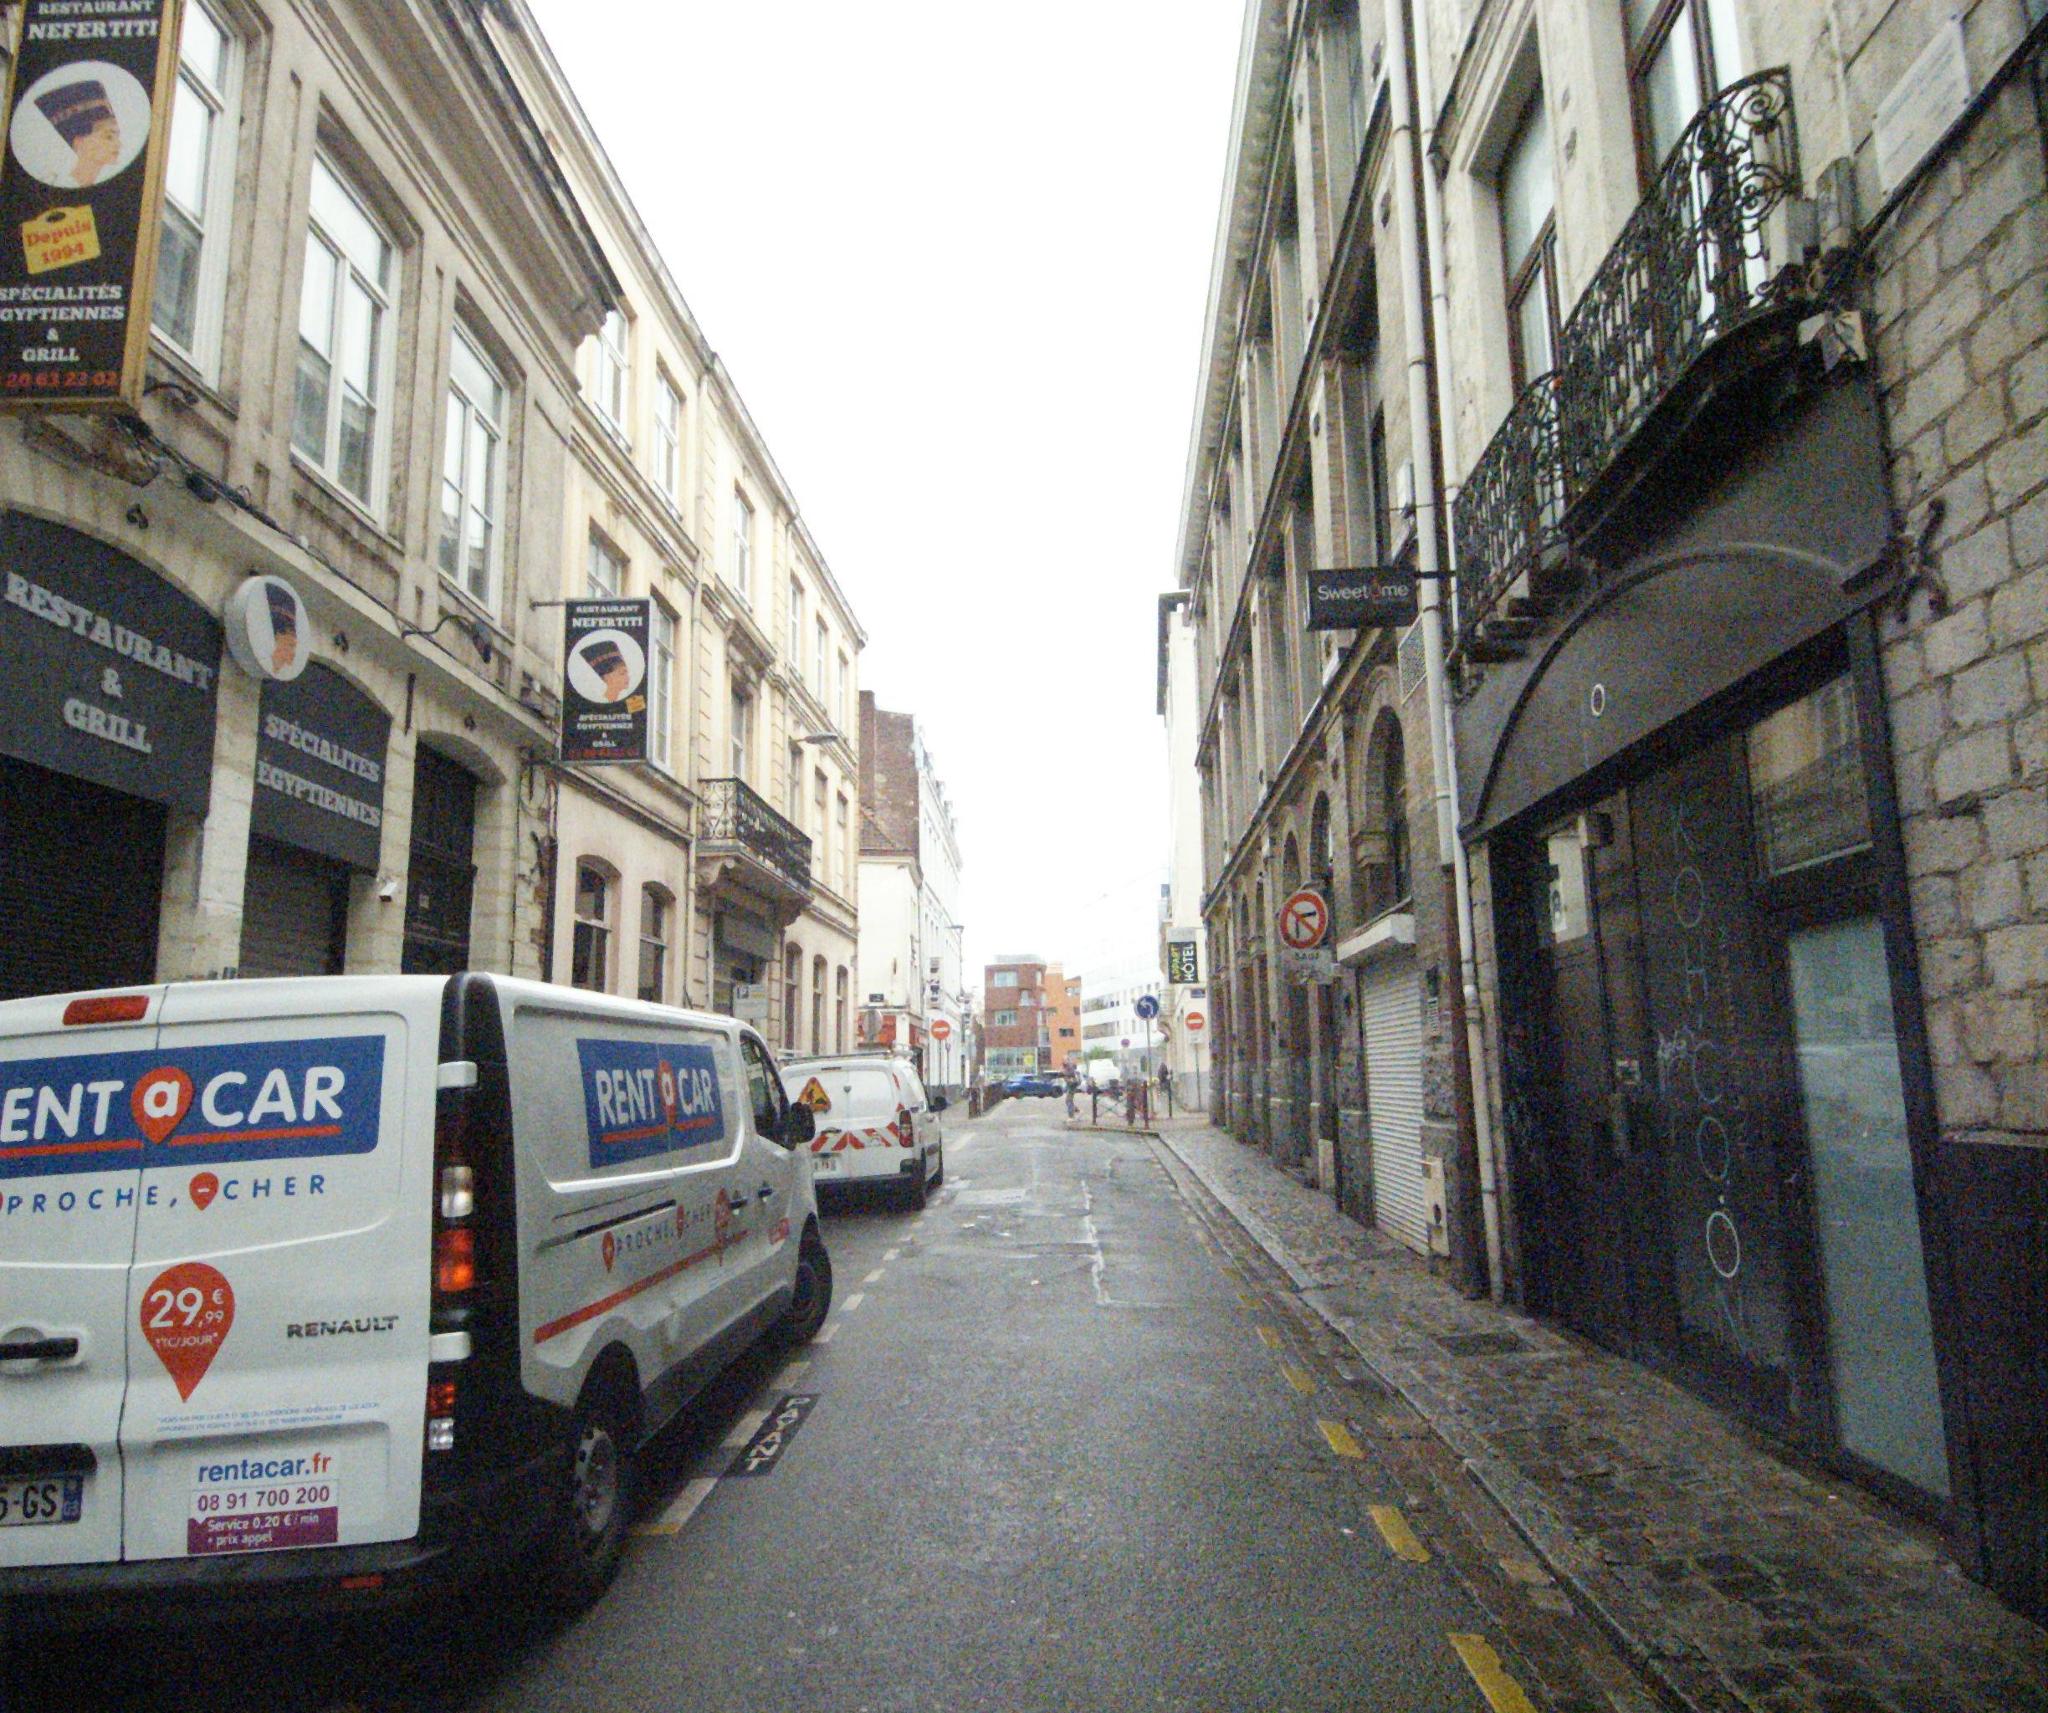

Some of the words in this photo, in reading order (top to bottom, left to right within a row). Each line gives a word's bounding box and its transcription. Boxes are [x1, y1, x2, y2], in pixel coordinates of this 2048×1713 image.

[39, 1, 154, 14] RESTAURANT
[28, 20, 159, 40] NEFERTITI
[26, 219, 92, 246] Depuis
[46, 328, 59, 341] &
[22, 348, 80, 362] GRILL
[572, 616, 643, 628] NEFERTITI
[576, 605, 640, 613] RESTAURANT
[4, 571, 213, 690] RESTAURANT
[101, 668, 122, 698] &
[63, 699, 151, 753] GRILL
[201, 1066, 345, 1127] CAR
[595, 1068, 656, 1127] RENT
[678, 1068, 715, 1116] CAR
[223, 1174, 325, 1200] CHER
[149, 1287, 203, 1328] 29
[287, 1315, 399, 1338] RENAULT
[198, 1452, 332, 1483] rentacar.fr
[197, 1494, 220, 1511] 08
[226, 1492, 247, 1509] 91
[256, 1489, 290, 1507] 700
[295, 1485, 330, 1505] 200
[207, 1517, 249, 1532] Service
[216, 1534, 238, 1549] prix
[242, 1530, 272, 1547] appel
